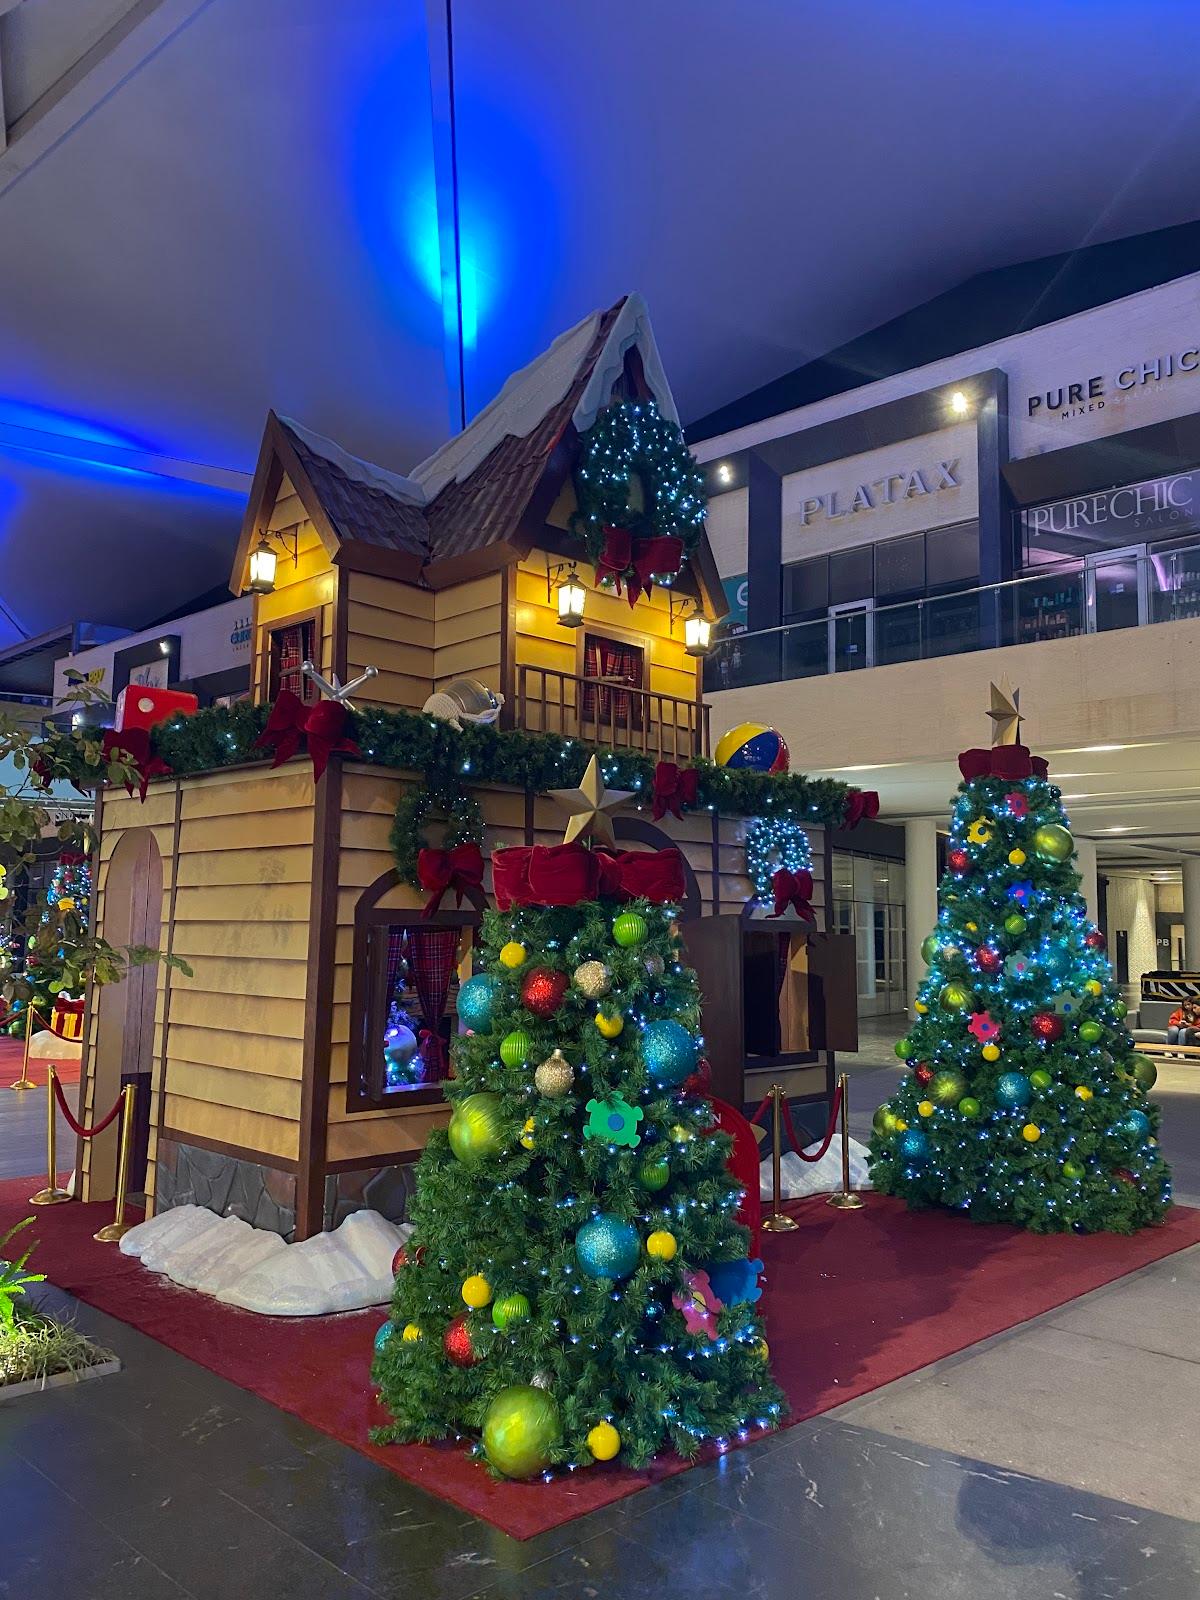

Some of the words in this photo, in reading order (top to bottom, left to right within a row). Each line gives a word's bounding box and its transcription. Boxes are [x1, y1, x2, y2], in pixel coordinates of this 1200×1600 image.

[1028, 376, 1104, 417] PURE
[1114, 348, 1200, 391] CHIC
[1061, 401, 1105, 421] MIXED
[799, 458, 961, 526] PLATAX
[1134, 508, 1193, 528] SALON
[1156, 938, 1170, 947] PB
